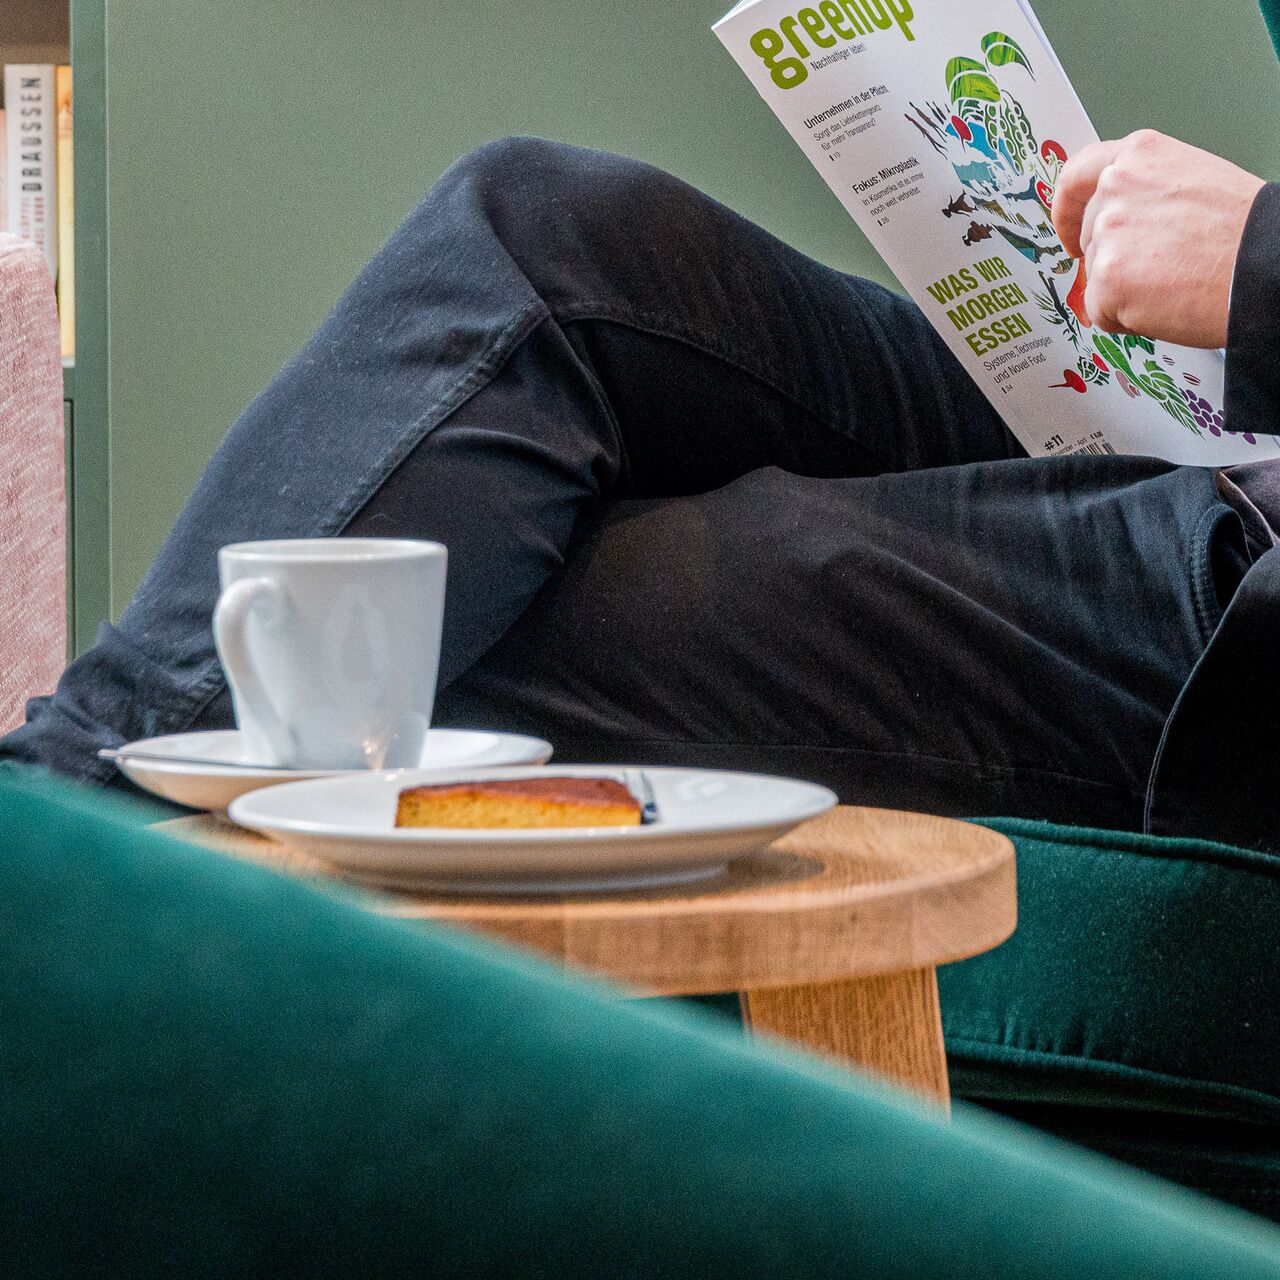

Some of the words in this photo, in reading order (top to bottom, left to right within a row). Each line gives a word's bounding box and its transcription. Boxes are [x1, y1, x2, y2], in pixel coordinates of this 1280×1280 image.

[810, 47, 852, 71] Nachhaltiger
[803, 98, 855, 129] Unternehmen
[851, 95, 861, 105] in
[859, 91, 871, 102] der
[21, 77, 42, 192] DRAUSSEN
[813, 128, 832, 141] Sorgt
[830, 121, 842, 133] das
[820, 141, 832, 152] für
[831, 132, 847, 147] mehr
[852, 175, 881, 195] Fokus:
[877, 156, 920, 181] Mikroplastik
[861, 198, 871, 207] In
[868, 183, 898, 203] Kosmetika
[870, 203, 887, 217] noch
[884, 197, 899, 209] weit
[926, 267, 979, 306] WAS
[972, 255, 1013, 283] WIR
[946, 282, 1029, 332] MORGEN
[965, 312, 1033, 357] ESSEN
[983, 348, 1020, 372] Systeme,
[1014, 335, 1053, 355] Technologien
[993, 368, 1010, 384] und
[1009, 358, 1032, 379] Novel
[1027, 352, 1048, 367] Food
[1044, 434, 1064, 452] #11
